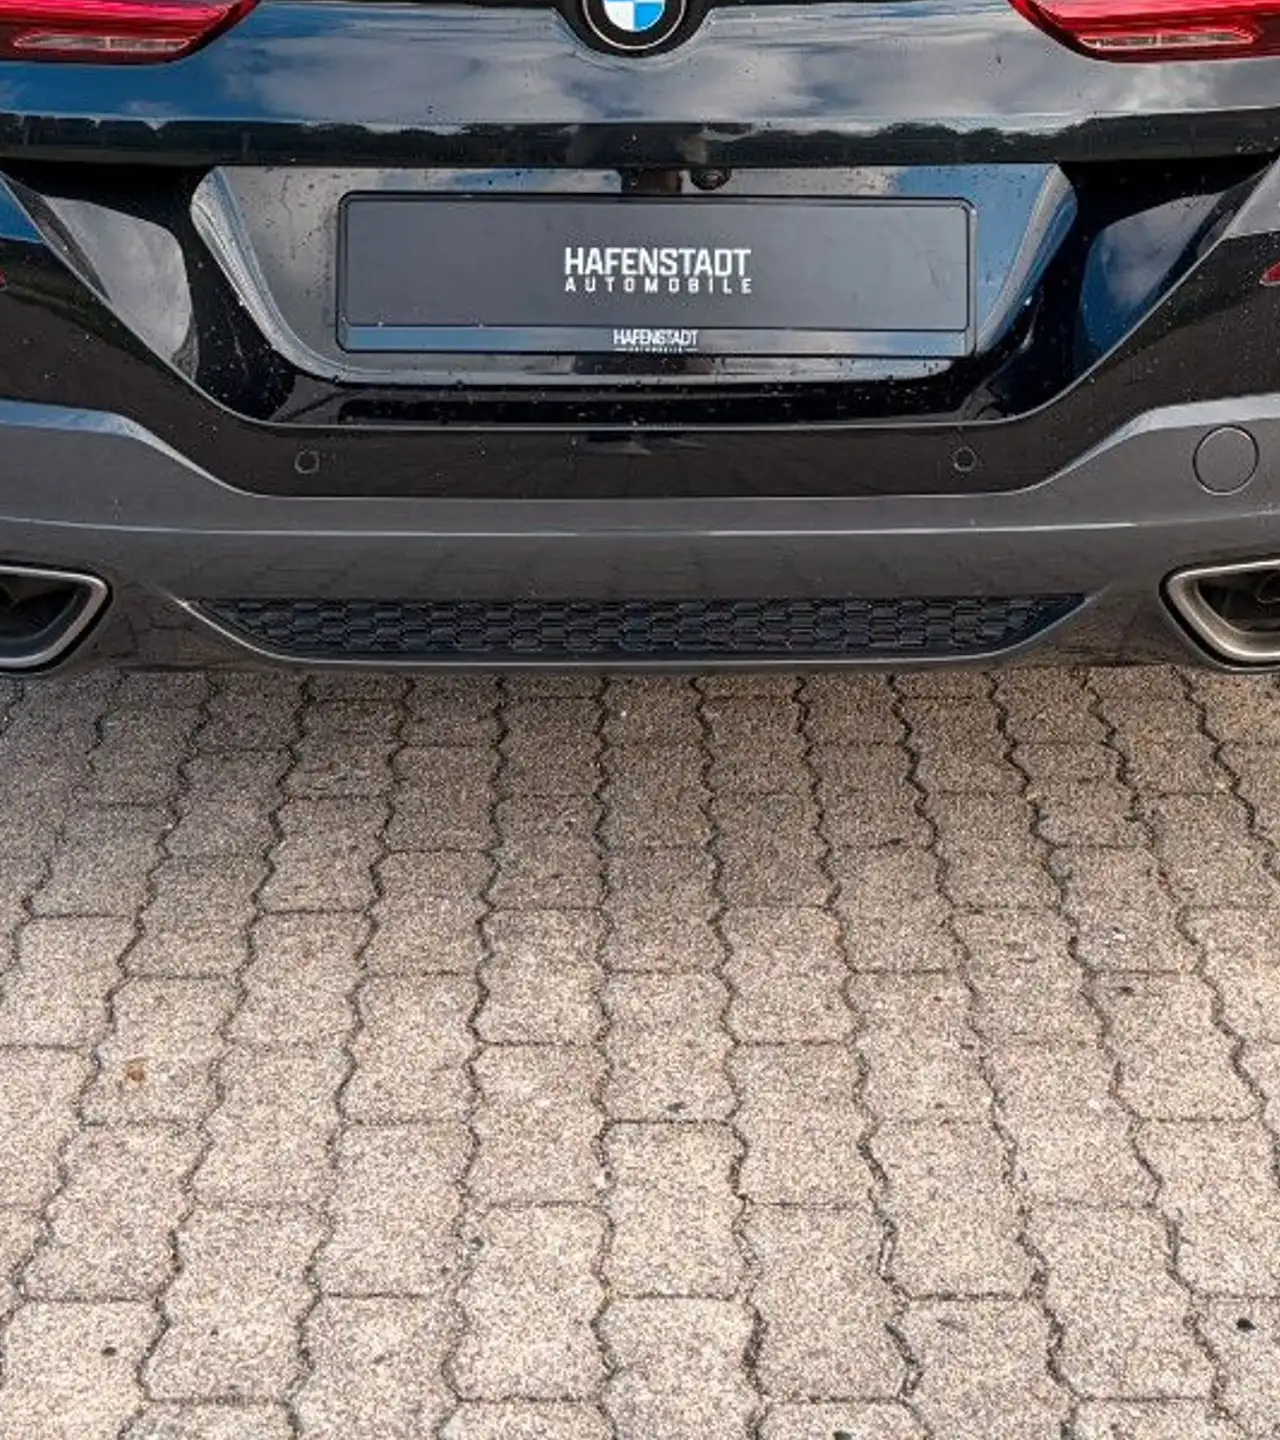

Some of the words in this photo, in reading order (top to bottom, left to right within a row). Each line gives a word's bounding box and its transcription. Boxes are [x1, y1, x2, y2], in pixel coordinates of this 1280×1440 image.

[564, 247, 752, 277] HAFENSTADT
[564, 277, 753, 295] AUTOMOBILE
[613, 328, 699, 346] HAFENSTADT
